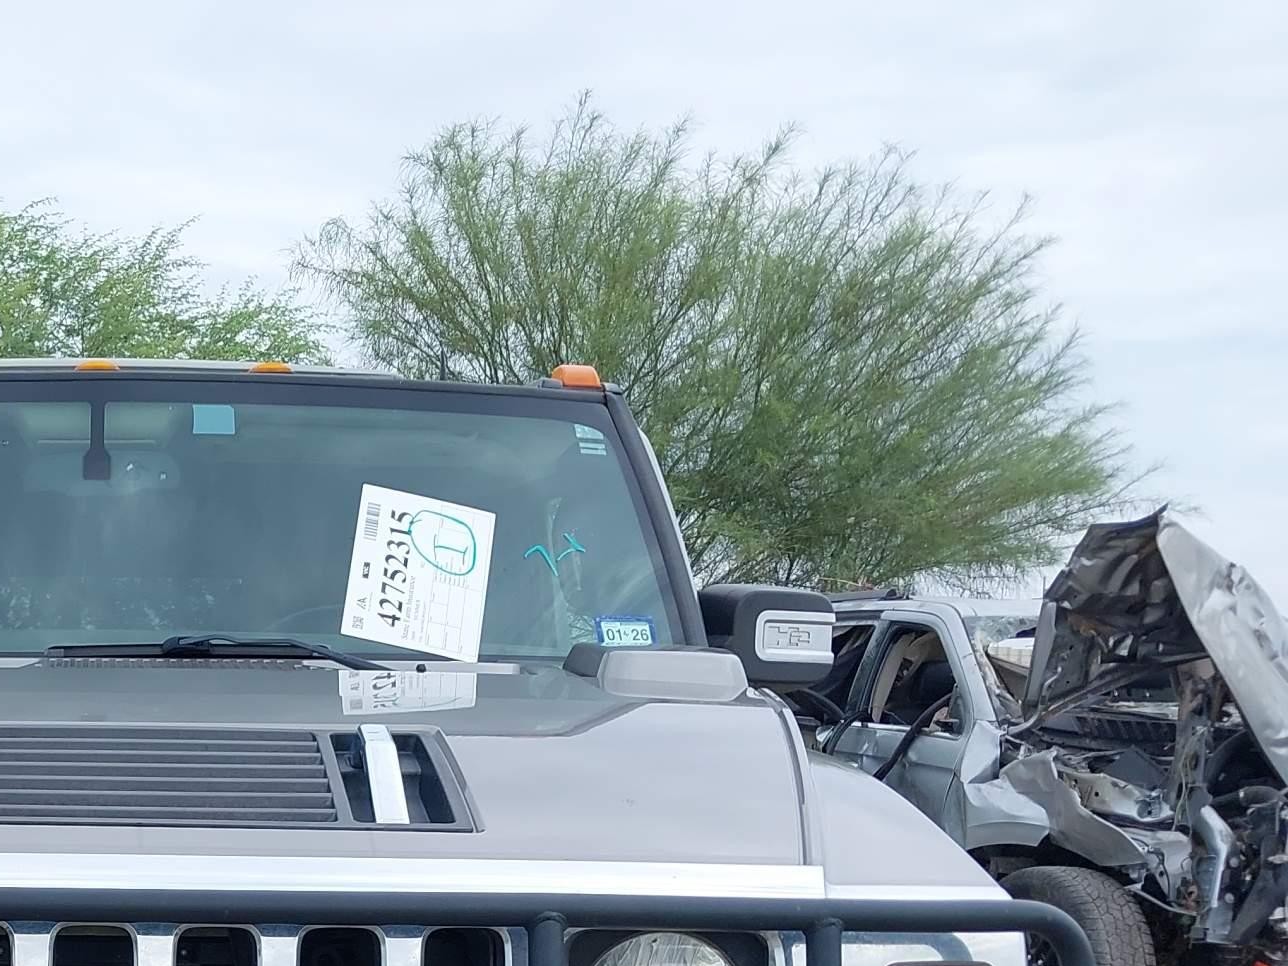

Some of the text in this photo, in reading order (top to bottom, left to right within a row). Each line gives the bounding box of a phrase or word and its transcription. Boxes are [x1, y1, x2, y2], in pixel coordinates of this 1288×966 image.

[377, 510, 414, 628] 42752315
[605, 628, 650, 641] 01 26
